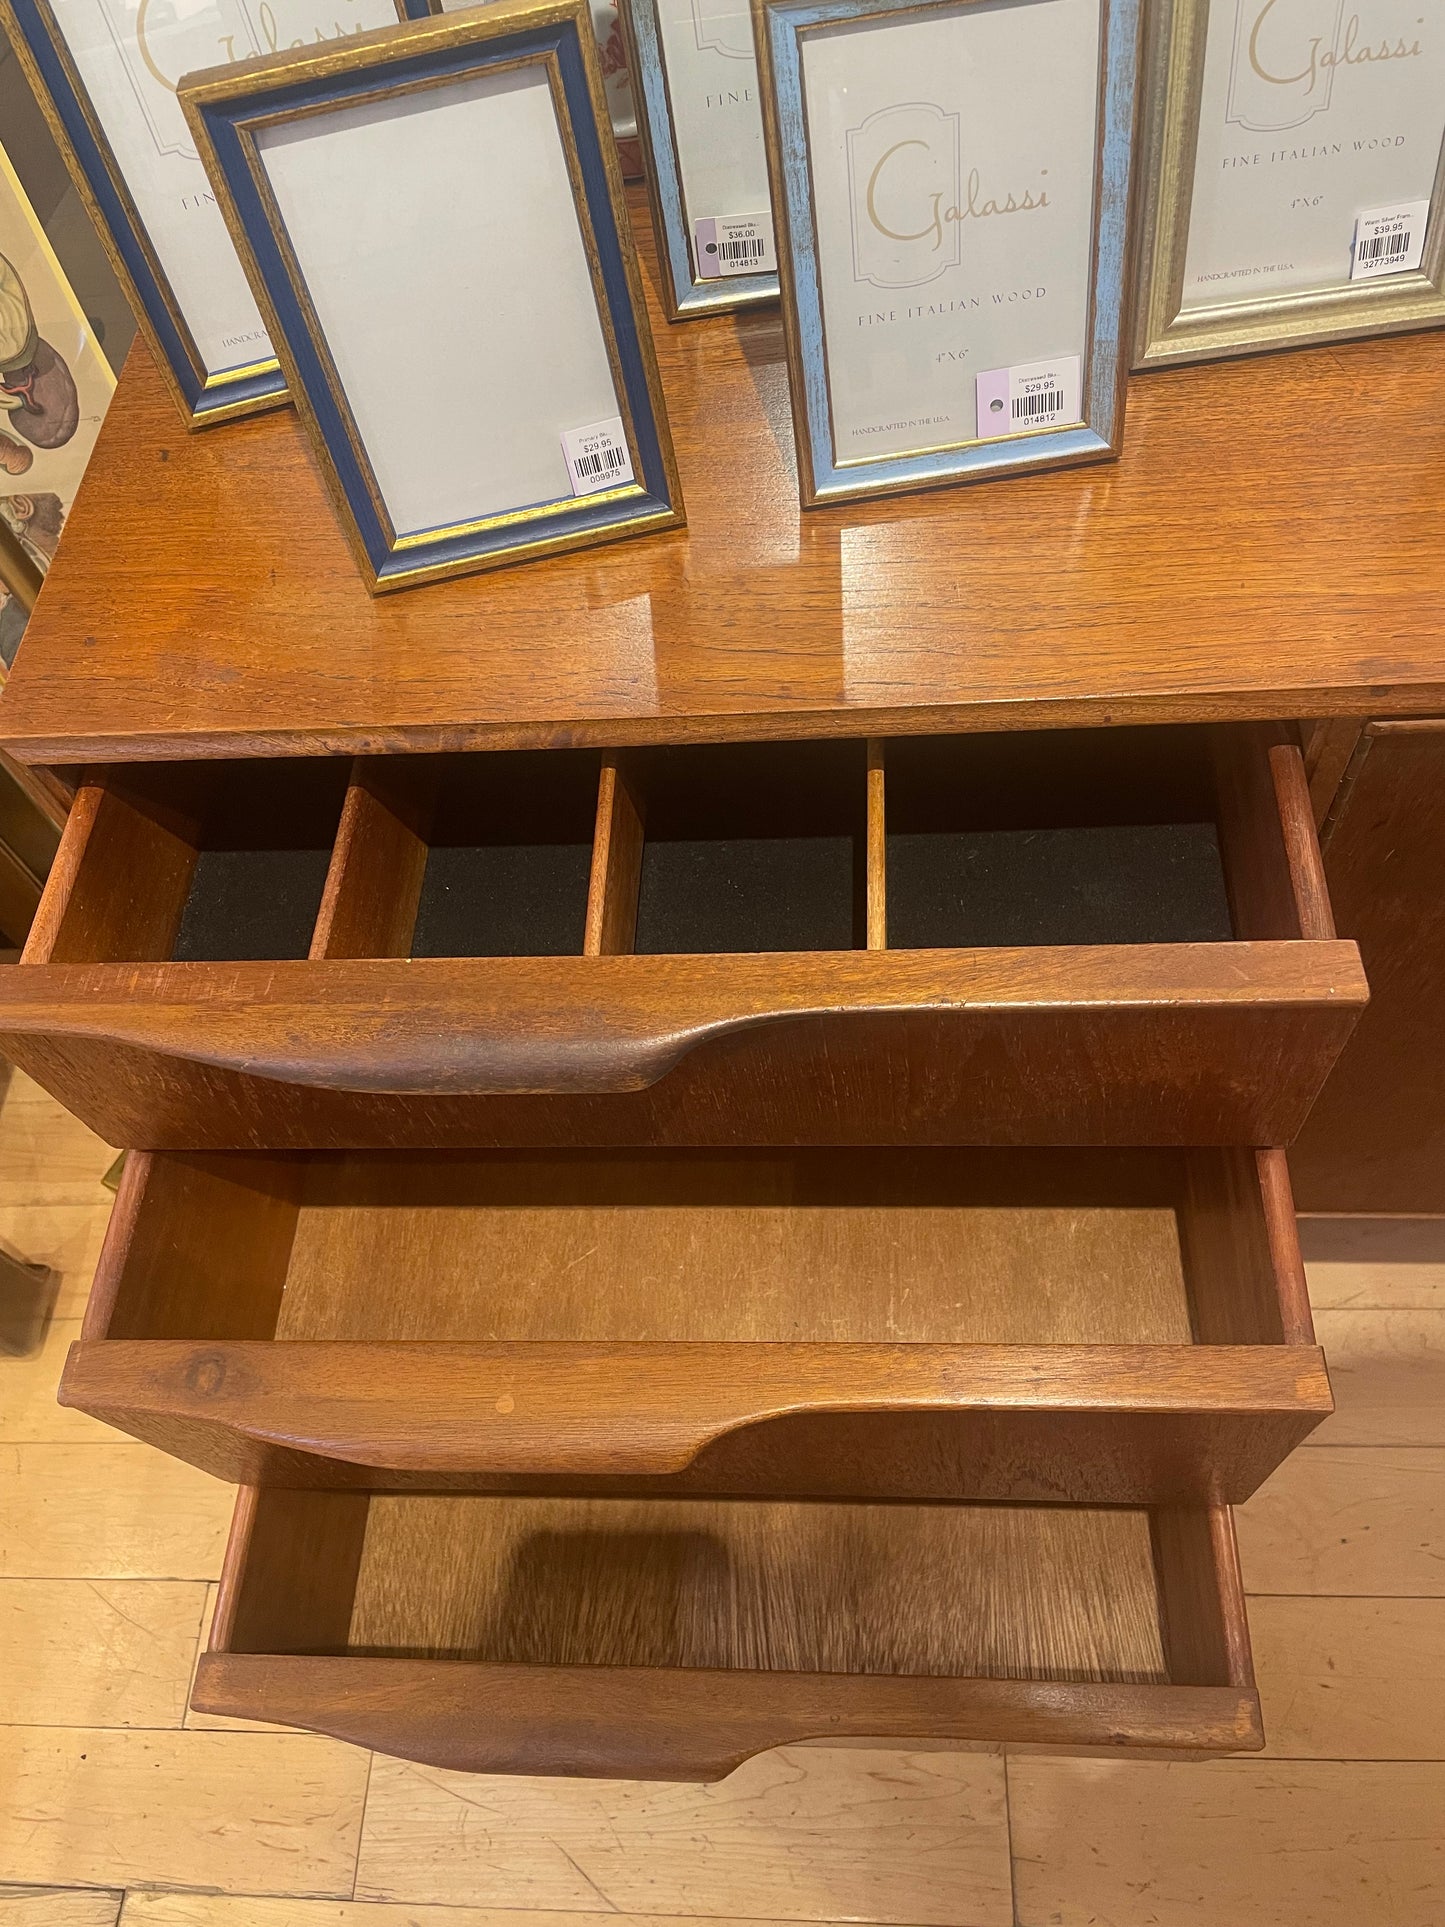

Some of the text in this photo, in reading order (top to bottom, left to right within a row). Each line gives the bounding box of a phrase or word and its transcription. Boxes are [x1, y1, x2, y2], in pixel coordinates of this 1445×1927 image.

[1249, 0, 1425, 97] Galassi
[706, 88, 752, 108] FINE
[1222, 135, 1406, 169] FINE ITALIAN WOOD
[866, 140, 1052, 252] Galassi
[728, 229, 755, 240] $36.00
[1373, 222, 1403, 235] $39.95
[729, 258, 759, 268] 014813
[1363, 254, 1405, 269] 32773949
[1197, 268, 1252, 282] HANDCRAFTED
[1252, 267, 1261, 275] IN
[1263, 264, 1276, 273] THE
[858, 287, 1047, 326] FINE ITALIAN WOOD
[1025, 380, 1055, 394] $29.95
[852, 422, 907, 436] HANDCRAFTED
[908, 419, 917, 427] IN
[918, 417, 932, 426] THE
[1023, 413, 1056, 426] 014812
[583, 438, 612, 453] $29.95
[590, 468, 621, 484] 009975
